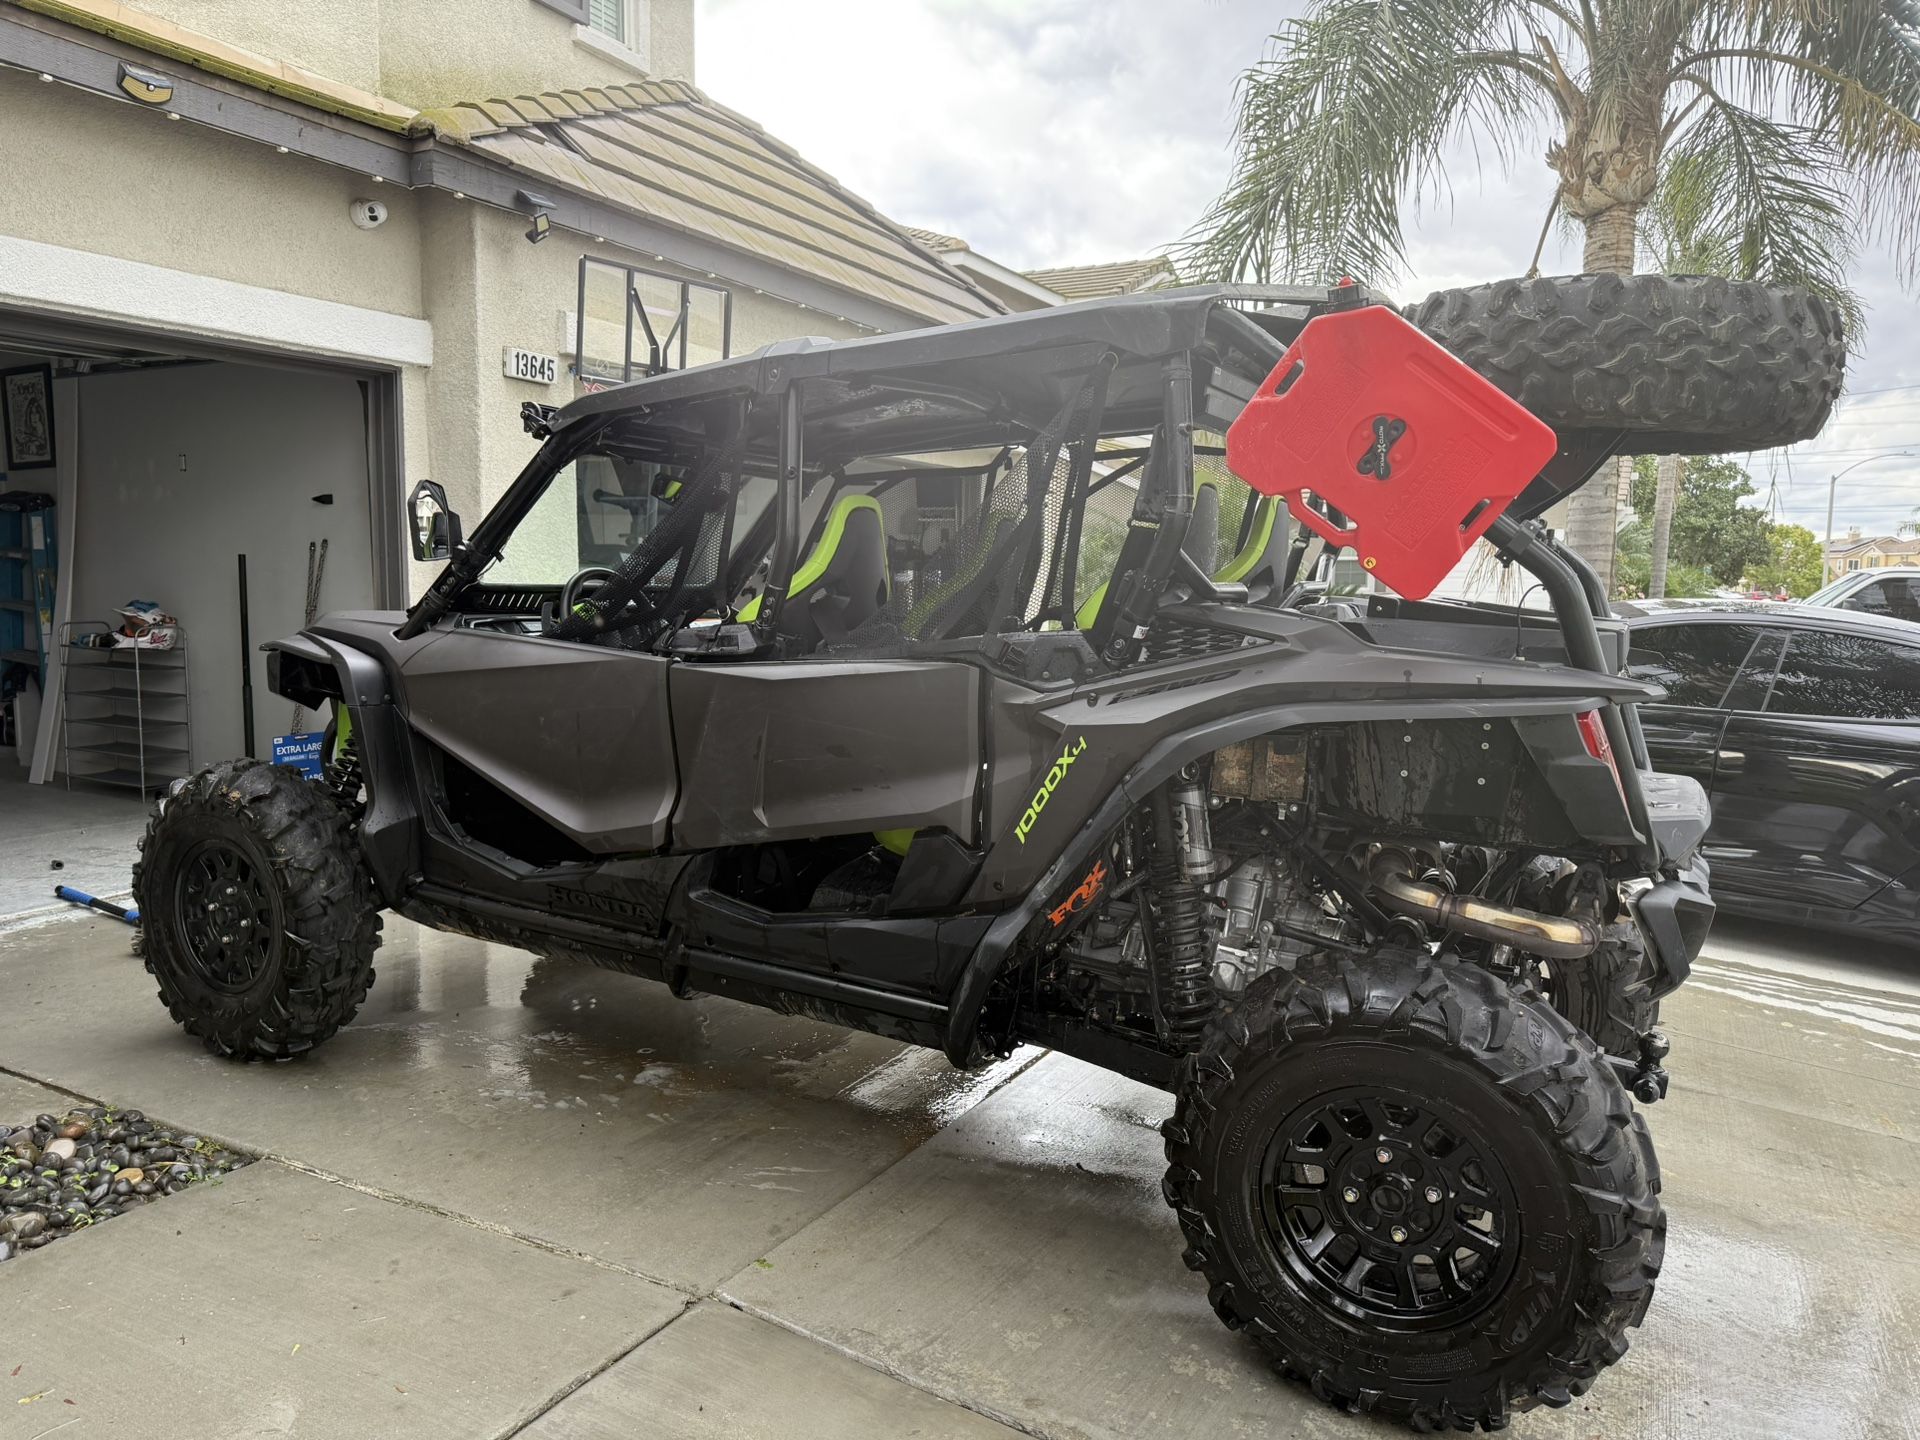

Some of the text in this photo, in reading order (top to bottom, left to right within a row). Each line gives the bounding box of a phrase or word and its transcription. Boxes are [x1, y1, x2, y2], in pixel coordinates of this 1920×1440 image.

[515, 351, 555, 382] 13645
[276, 742, 323, 756] EXTRA LARG
[1014, 735, 1088, 845] 1000X4
[1172, 803, 1191, 853] FOX
[1047, 859, 1107, 927] FOX
